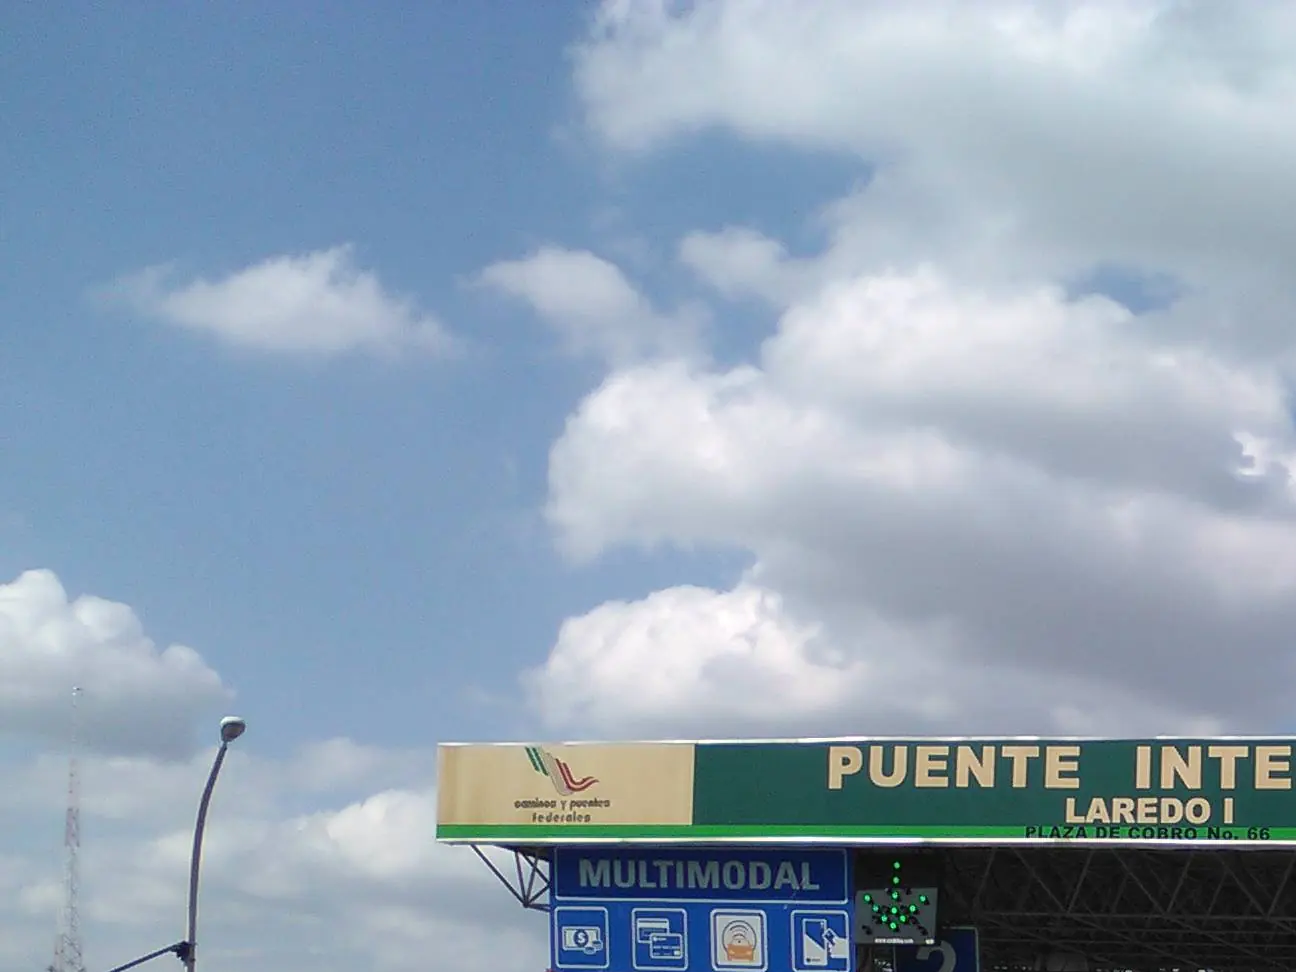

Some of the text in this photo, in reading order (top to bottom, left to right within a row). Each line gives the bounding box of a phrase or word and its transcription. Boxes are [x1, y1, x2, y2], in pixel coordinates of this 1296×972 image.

[827, 745, 1082, 790] PUENTE
[531, 810, 592, 823] federales
[1065, 797, 1234, 824] LAREDO I
[1025, 825, 1271, 840] PLAZA DE COBRO No. 66
[578, 858, 820, 891] MULTIMODAL
